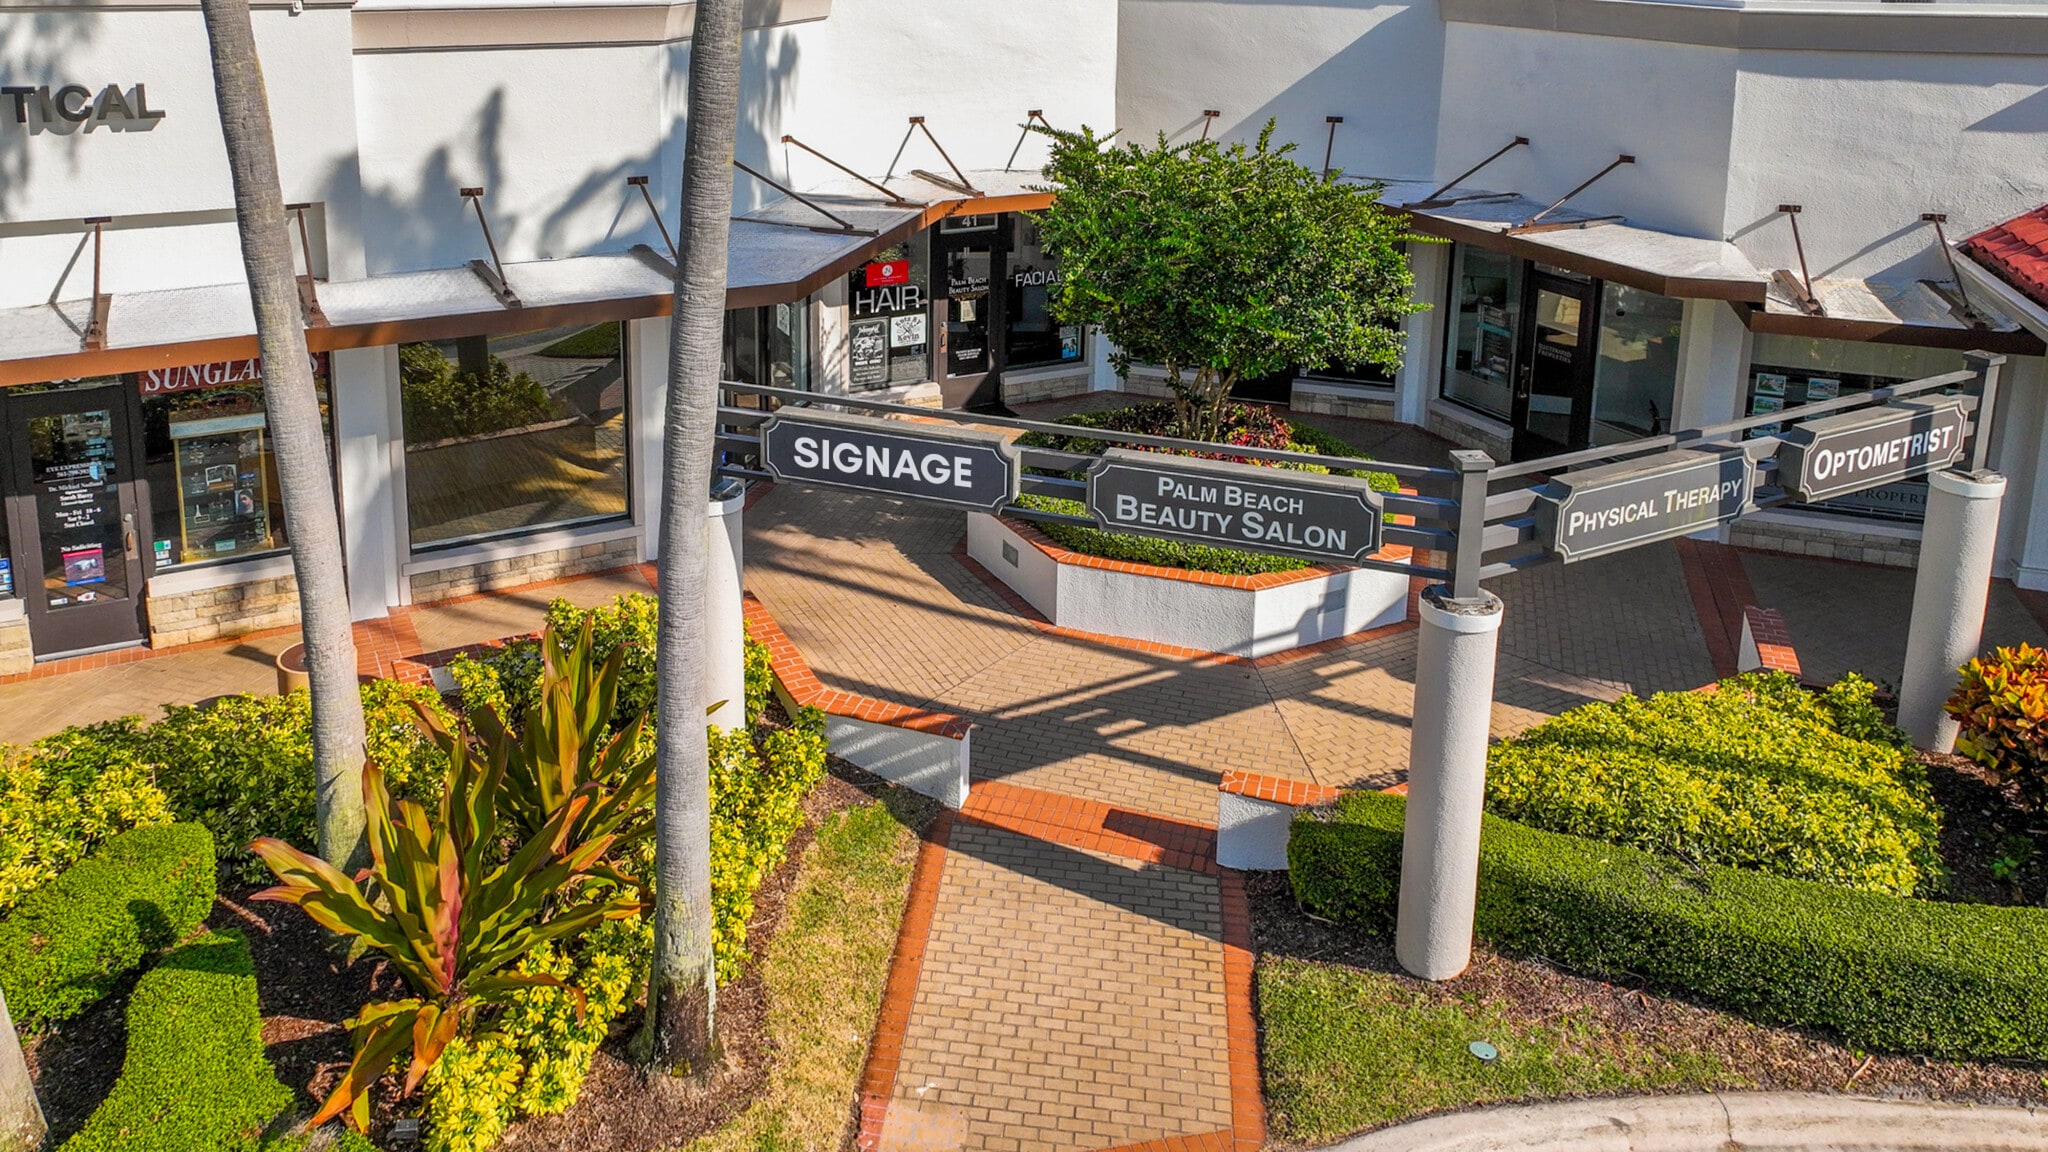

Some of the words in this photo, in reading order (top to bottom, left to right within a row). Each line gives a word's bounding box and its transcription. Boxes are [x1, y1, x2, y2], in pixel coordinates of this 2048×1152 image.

[1, 83, 166, 123] TICAL
[962, 214, 977, 227] 41
[855, 285, 920, 315] HAIR
[793, 437, 973, 488] SIGNAGE
[1813, 425, 1954, 480] OPTOMETRIST
[1157, 476, 1217, 504] PALM
[1224, 485, 1304, 515] BEACH
[1568, 499, 1659, 537] PHYSICAL
[1663, 478, 1743, 514] THERAPY
[1115, 494, 1233, 534] BEAUTY
[1241, 511, 1347, 551] SALON
